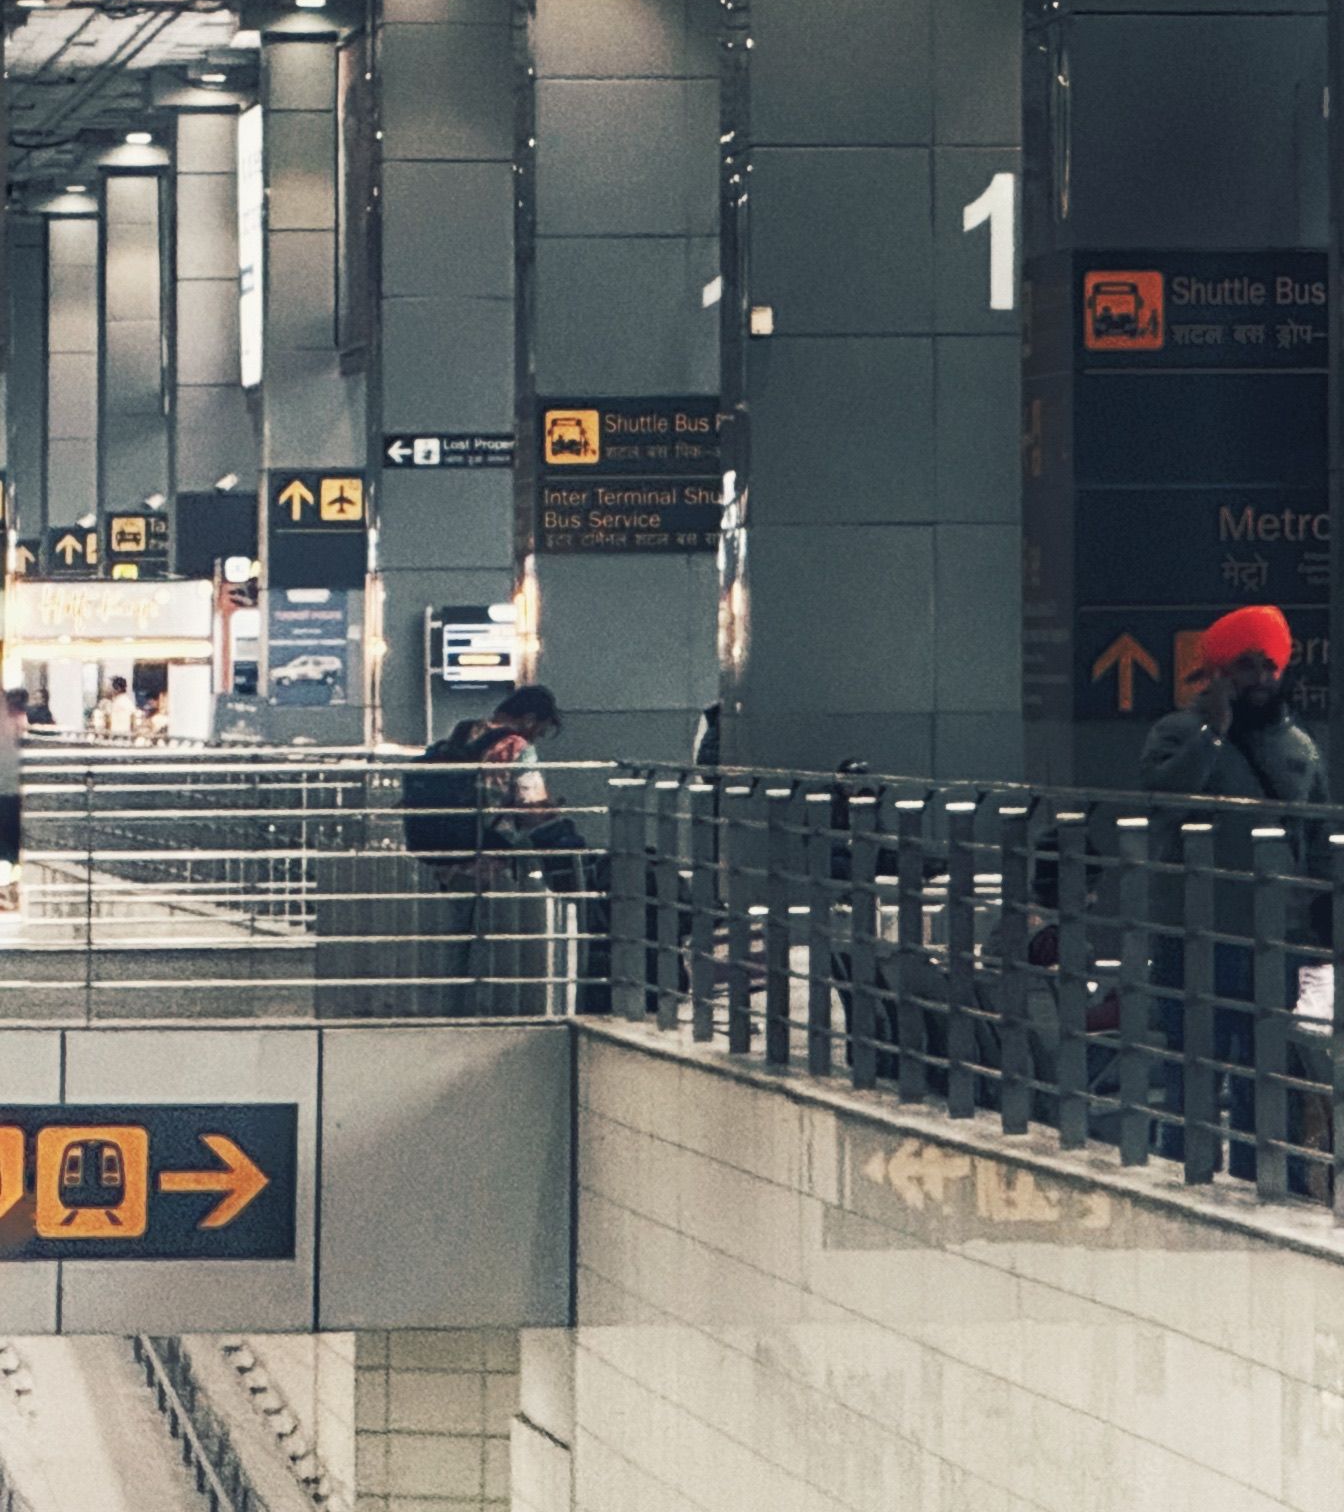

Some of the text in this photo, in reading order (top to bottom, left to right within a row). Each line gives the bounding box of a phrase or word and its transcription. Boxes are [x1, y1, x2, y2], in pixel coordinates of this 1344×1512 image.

[1172, 276, 1326, 305] Shuttle Bus
[604, 413, 668, 433] Shuttle
[675, 412, 710, 433] Bus
[443, 438, 470, 450] Lost
[544, 489, 587, 505] Inter
[597, 489, 677, 505] Terminal
[544, 511, 662, 528] Bus Service
